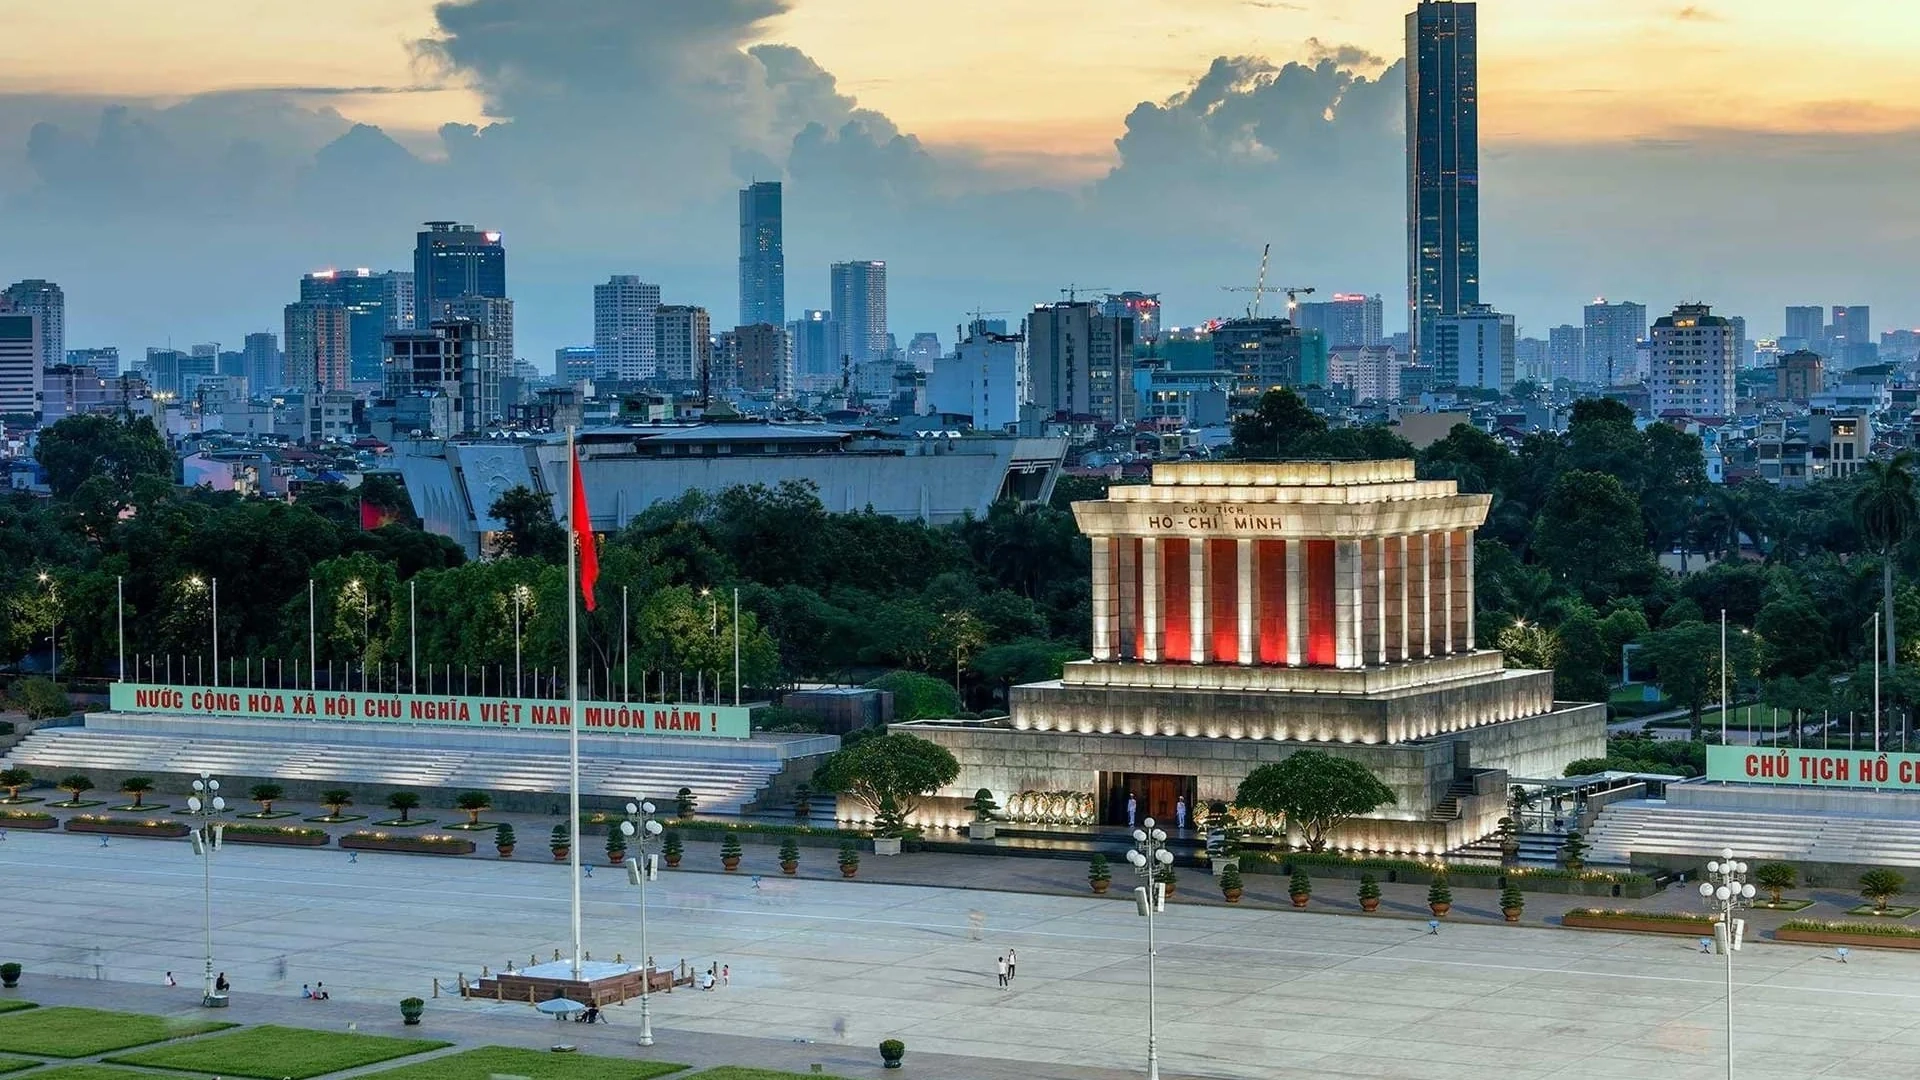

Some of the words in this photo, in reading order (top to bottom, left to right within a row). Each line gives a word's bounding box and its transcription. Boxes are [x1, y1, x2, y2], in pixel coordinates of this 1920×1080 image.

[136, 688, 184, 709] NƯỚC
[191, 690, 240, 713] CỘNG
[248, 691, 285, 714] HÒA
[292, 693, 317, 715] XÃ
[324, 694, 356, 719] HỘI
[364, 695, 403, 718] CHỦ
[410, 698, 471, 722] NGHĨA
[479, 700, 523, 726] VIỆT
[585, 705, 645, 729] MUÔN
[654, 707, 701, 731] NĂM
[1745, 749, 1790, 778] CHỦ
[1799, 756, 1850, 783] TỊCH
[1859, 753, 1889, 783] HỒ
